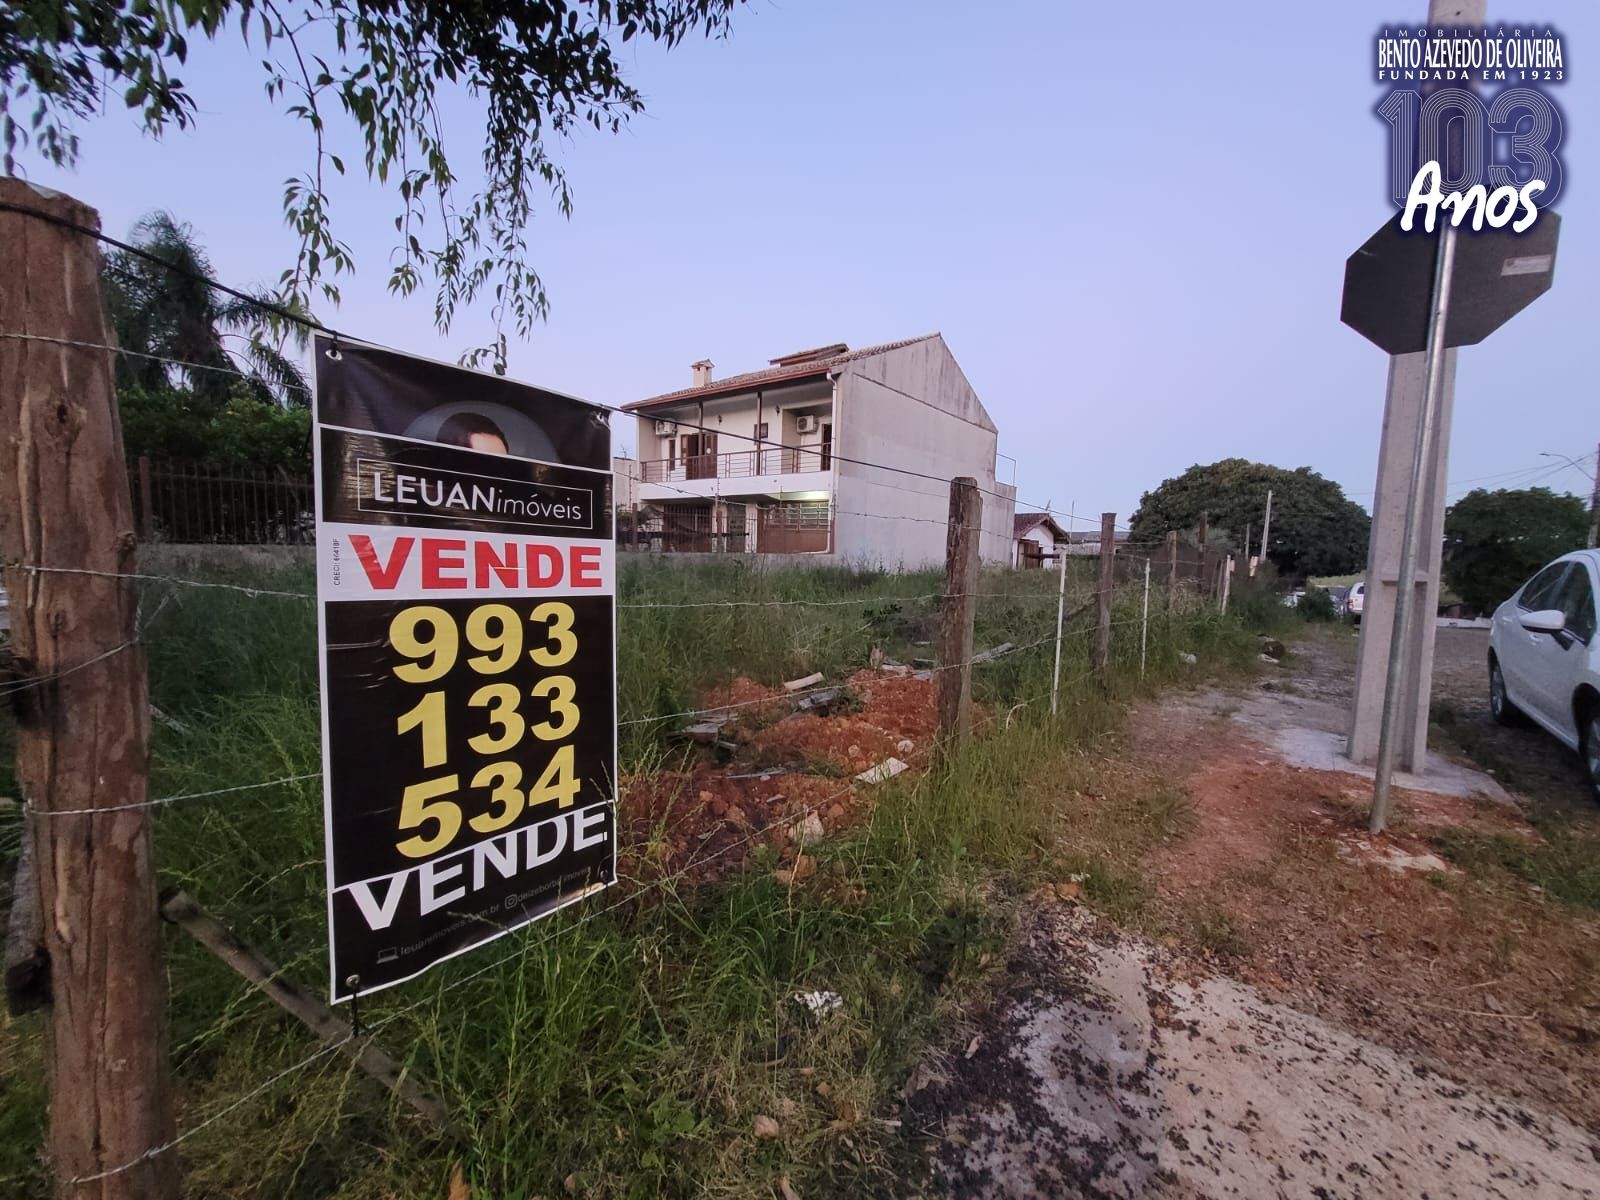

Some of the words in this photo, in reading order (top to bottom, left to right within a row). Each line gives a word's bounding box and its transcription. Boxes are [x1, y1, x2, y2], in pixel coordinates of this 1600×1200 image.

[347, 534, 603, 590] VENDE
[389, 602, 578, 683] 993
[397, 675, 580, 768] 133
[395, 744, 580, 858] 534
[348, 808, 607, 931] VENDE
